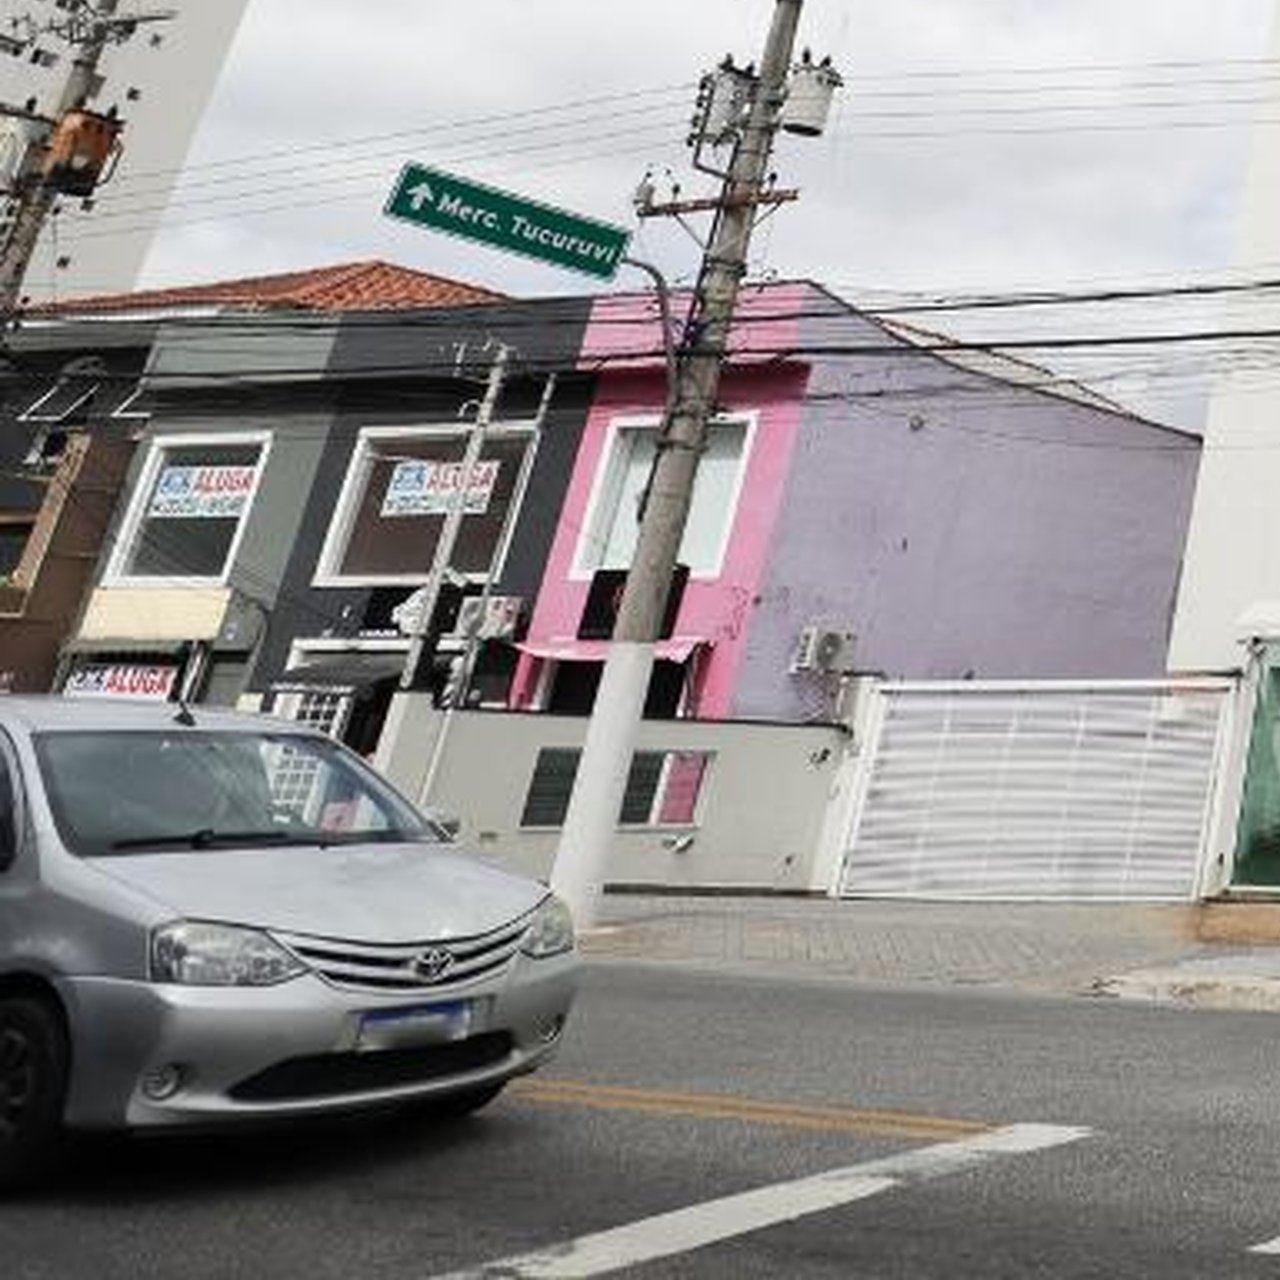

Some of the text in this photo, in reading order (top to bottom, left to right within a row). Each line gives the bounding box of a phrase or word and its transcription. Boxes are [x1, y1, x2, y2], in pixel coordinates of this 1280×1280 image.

[435, 192, 616, 263] Merc. Tucuruvi
[105, 666, 172, 694] ALUGA
